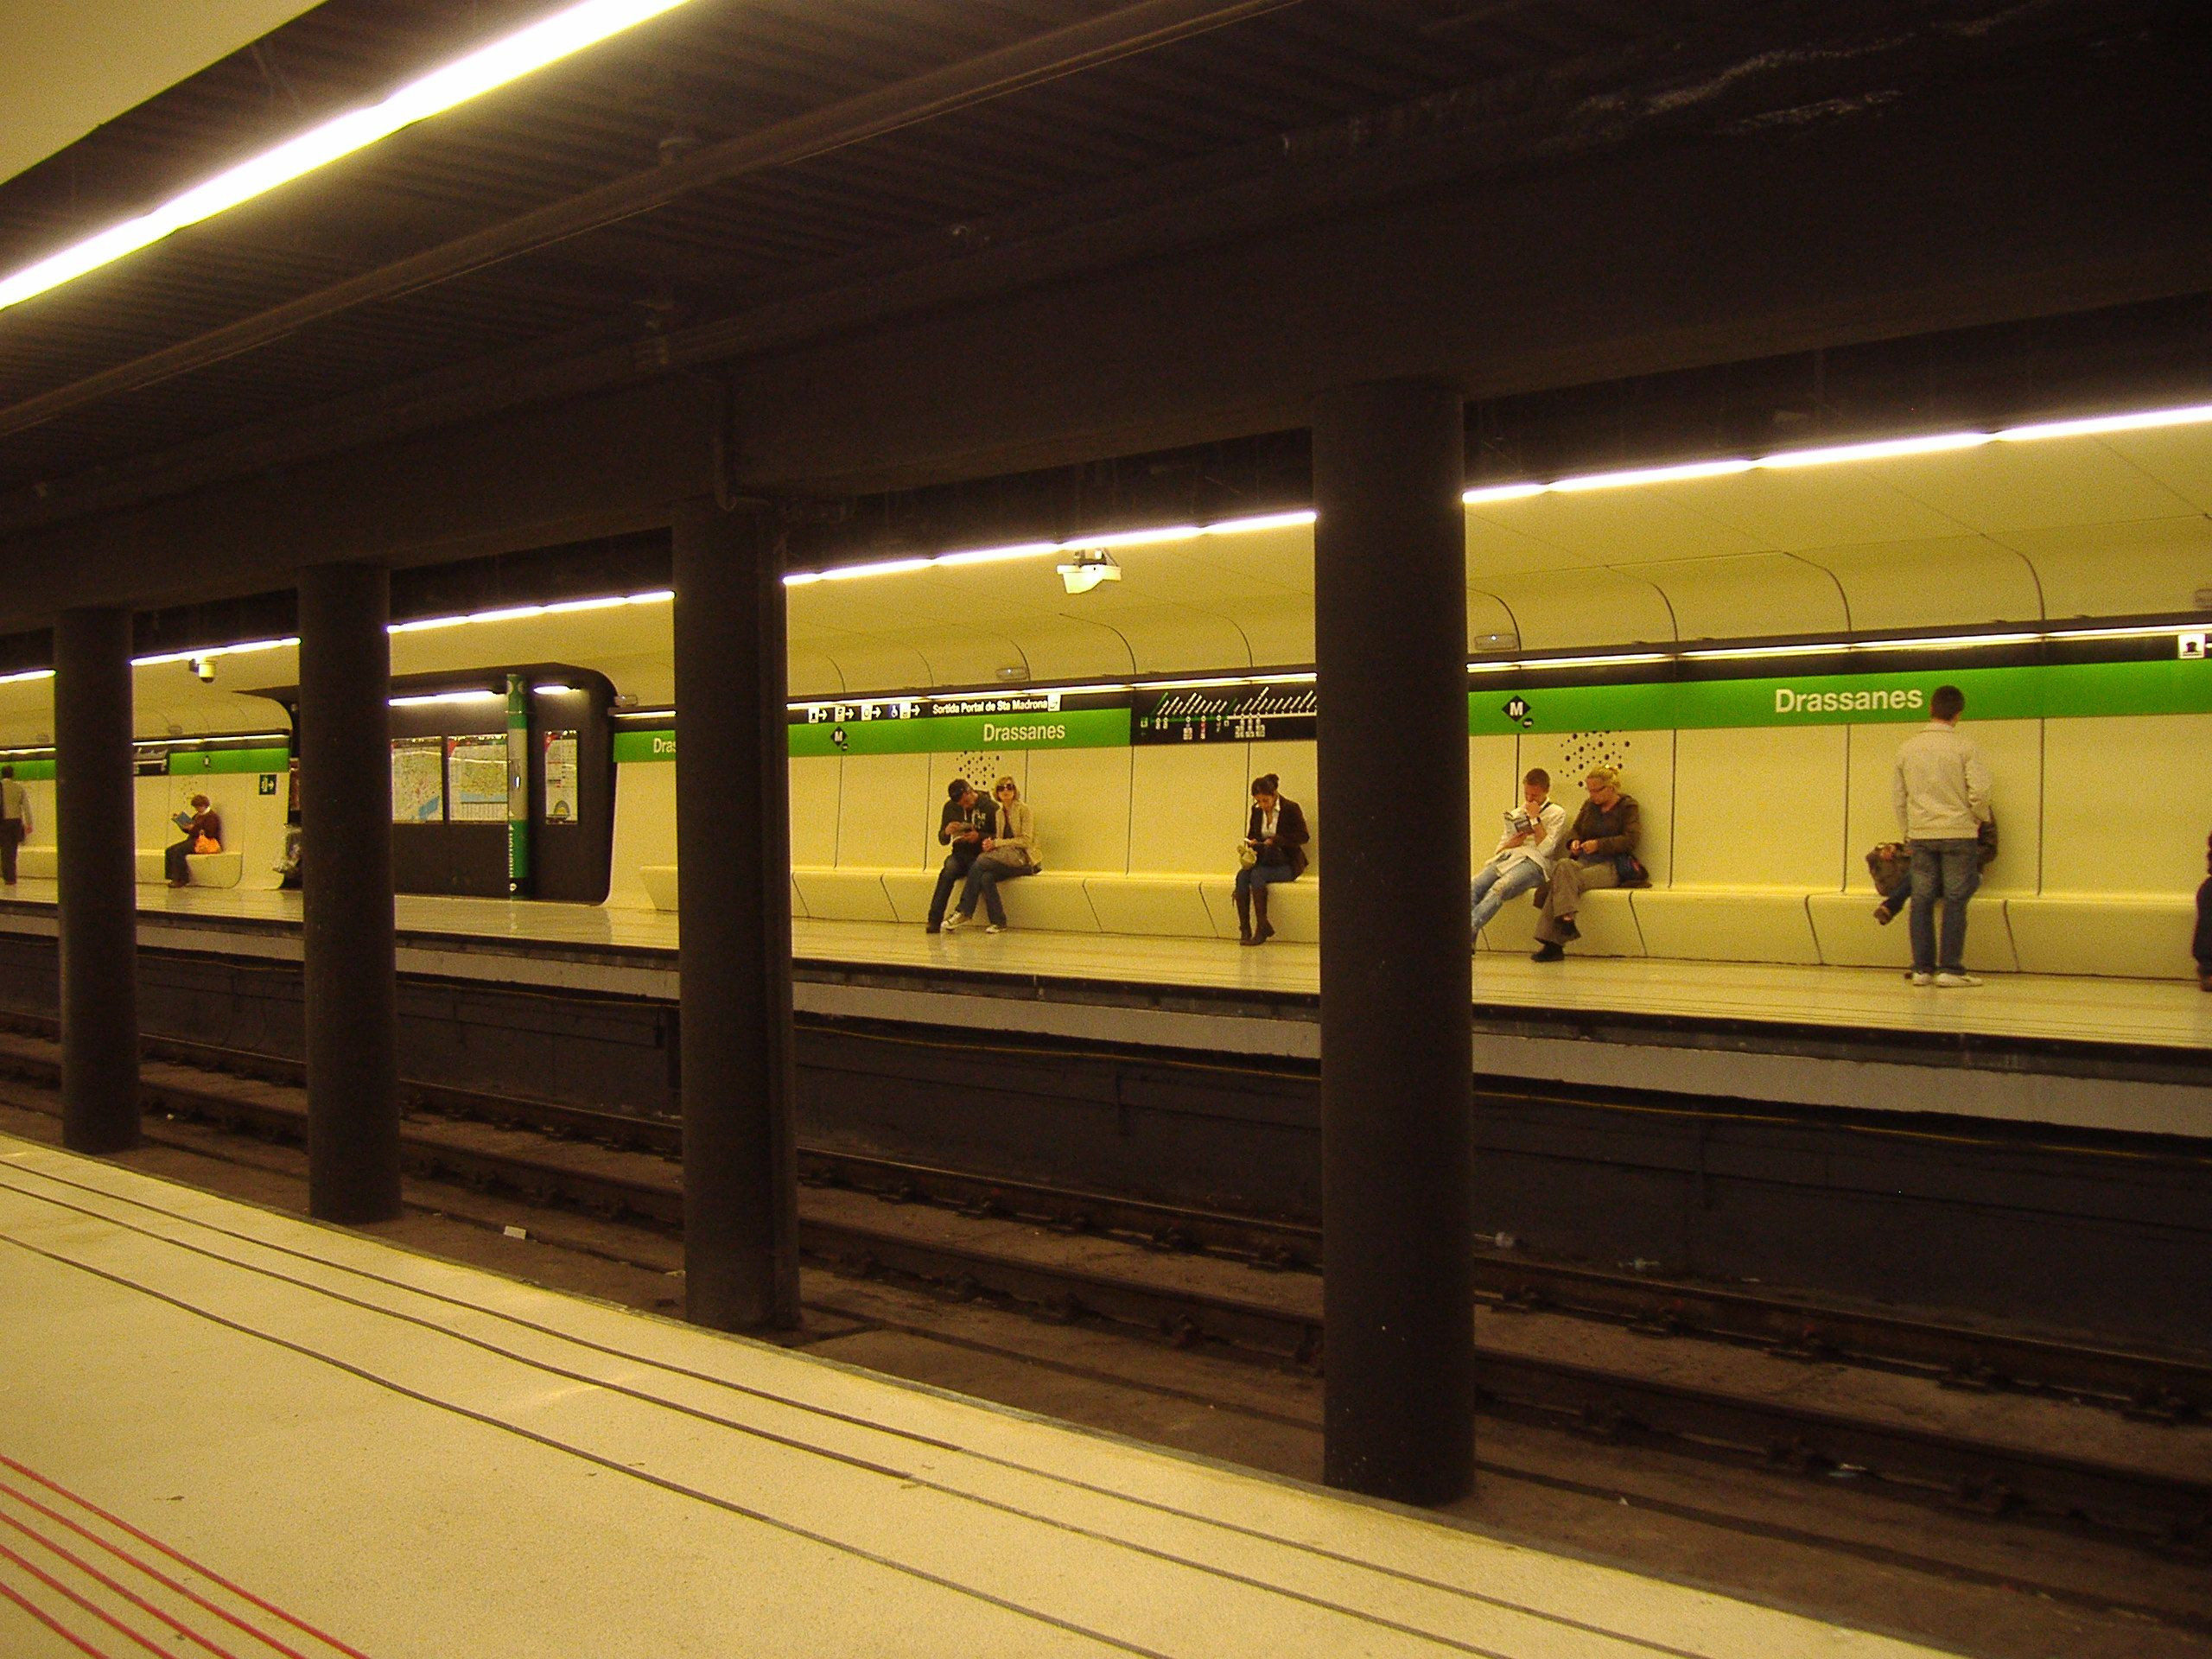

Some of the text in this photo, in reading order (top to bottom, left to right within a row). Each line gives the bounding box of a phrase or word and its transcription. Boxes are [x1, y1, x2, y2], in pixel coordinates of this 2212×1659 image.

[932, 698, 1048, 715] Sortida Portal de Sta Madrona
[1510, 701, 1524, 716] M
[1775, 688, 1923, 714] Drassanes
[983, 722, 1065, 742] Drassanes
